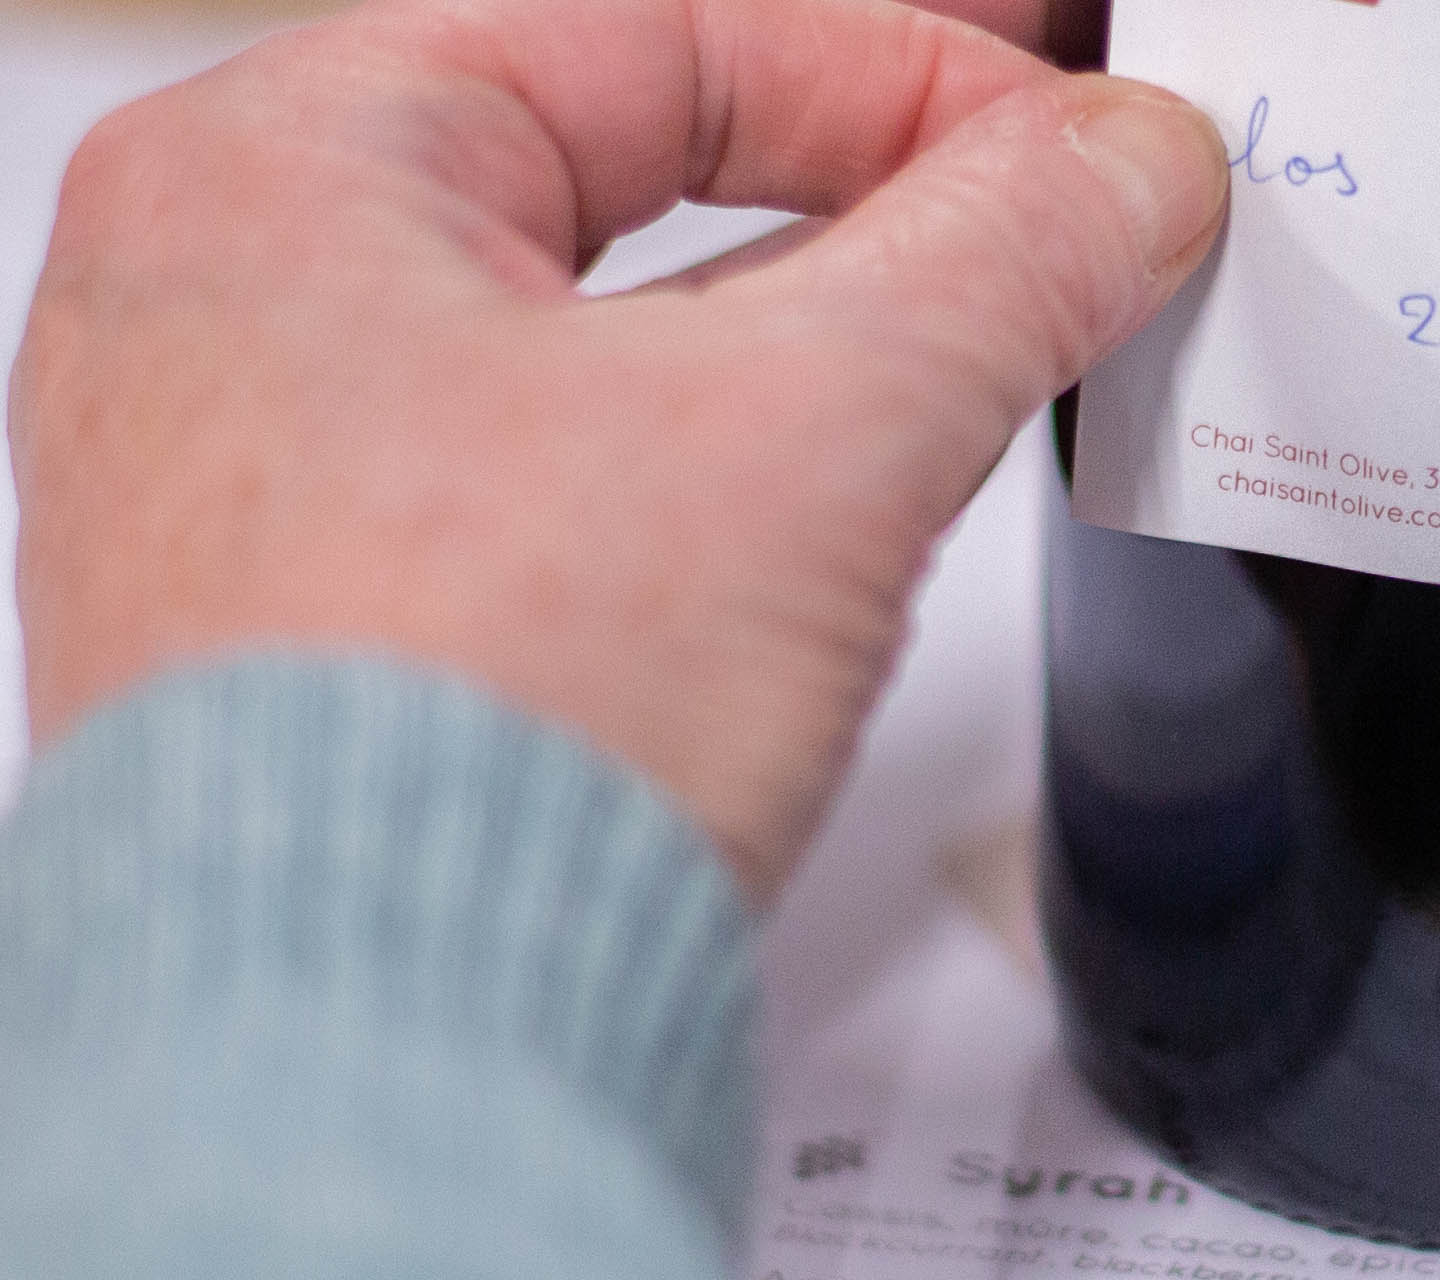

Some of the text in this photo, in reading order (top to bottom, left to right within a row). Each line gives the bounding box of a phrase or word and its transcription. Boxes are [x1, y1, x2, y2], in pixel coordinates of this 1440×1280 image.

[1227, 95, 1359, 198] los
[1191, 424, 1254, 454] Chai
[1264, 434, 1329, 471] Saint
[1339, 453, 1414, 490] Olive,
